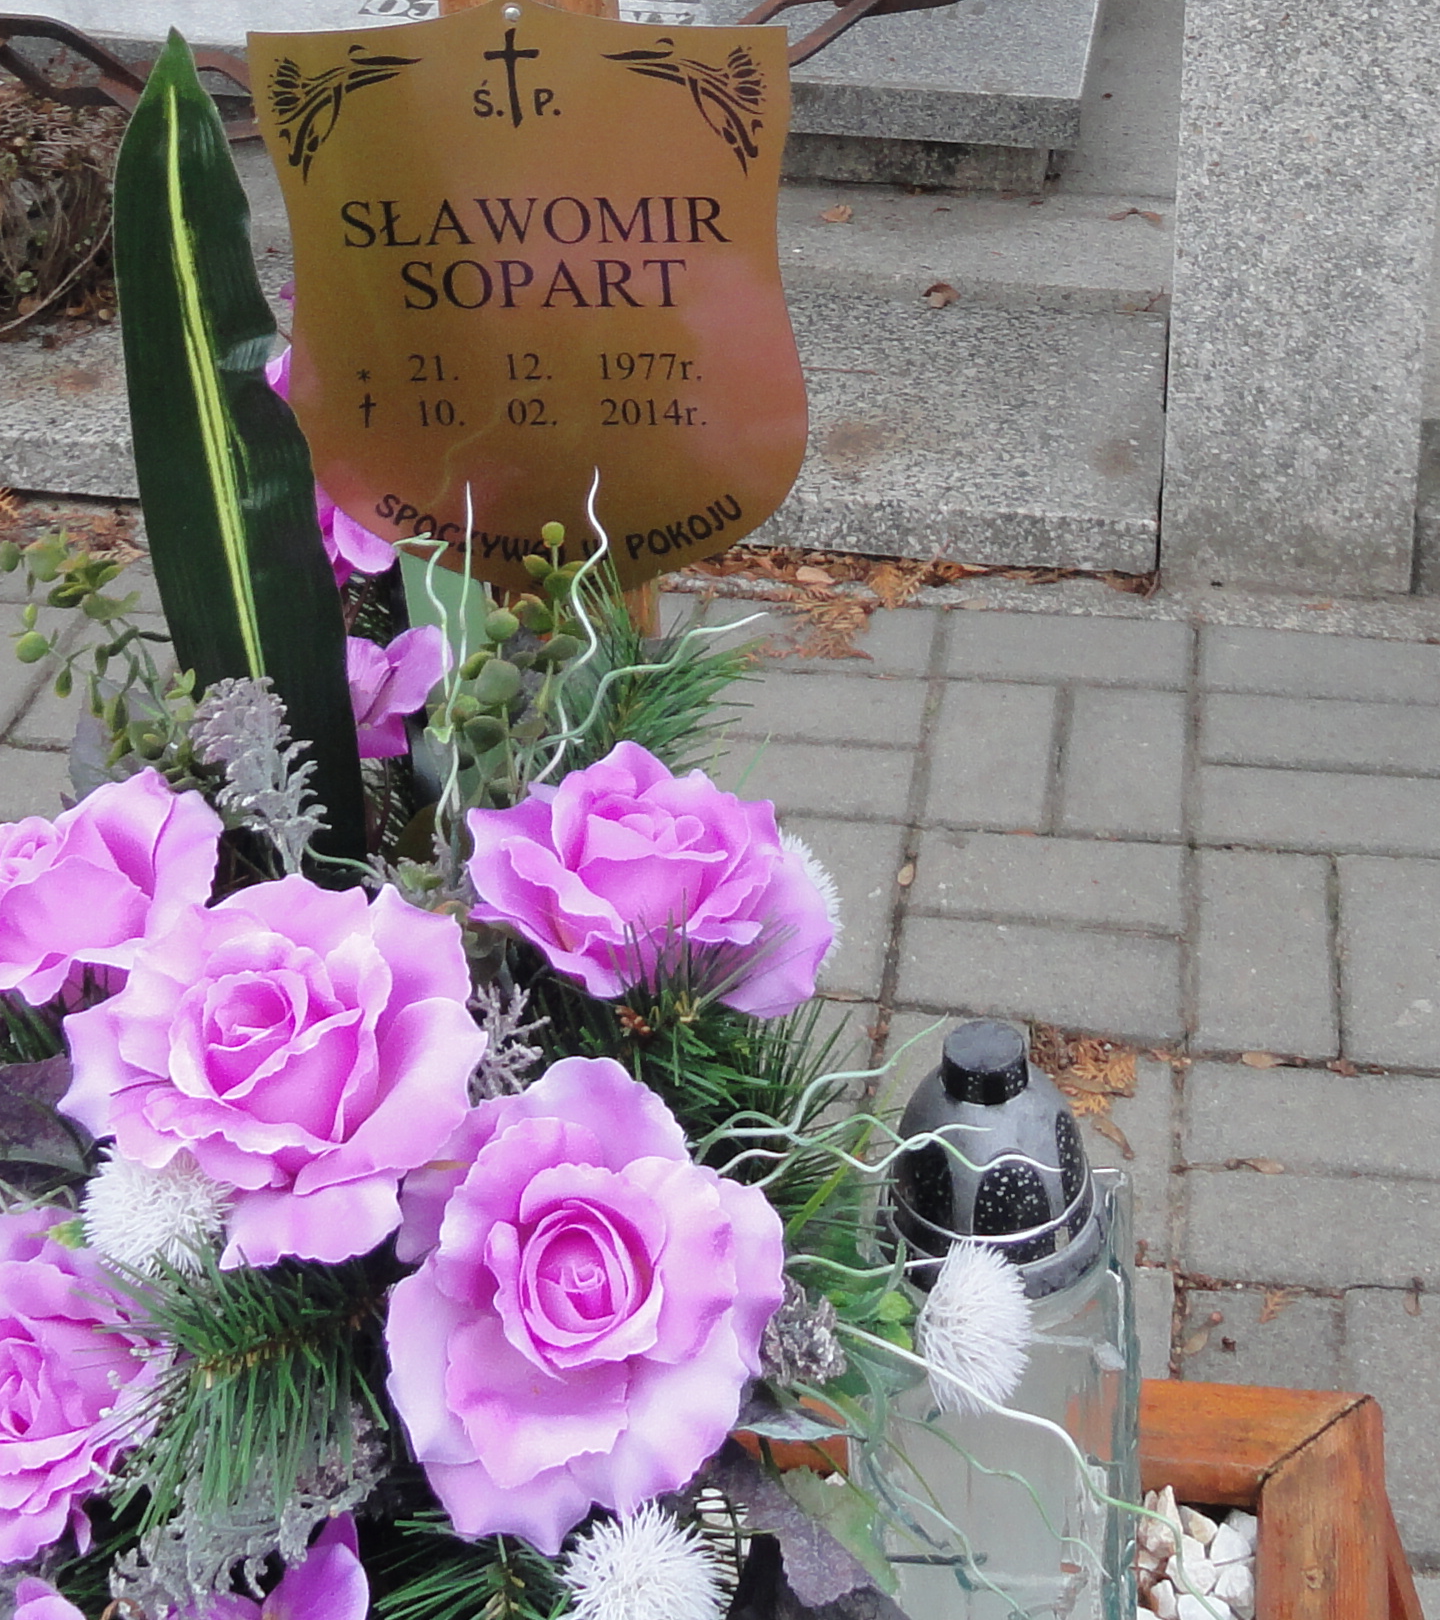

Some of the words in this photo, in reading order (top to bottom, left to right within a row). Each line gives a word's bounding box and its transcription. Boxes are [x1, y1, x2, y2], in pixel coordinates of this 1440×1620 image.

[341, 195, 732, 249] SŁAWOMIR
[401, 258, 687, 311] SOPART
[408, 352, 459, 382] 21.
[506, 352, 553, 381] 12.
[599, 352, 703, 382] 1977r.
[418, 398, 465, 428] 10.
[507, 397, 558, 427] 02.
[600, 397, 707, 427] 2014r.
[624, 494, 743, 560] POKOJU
